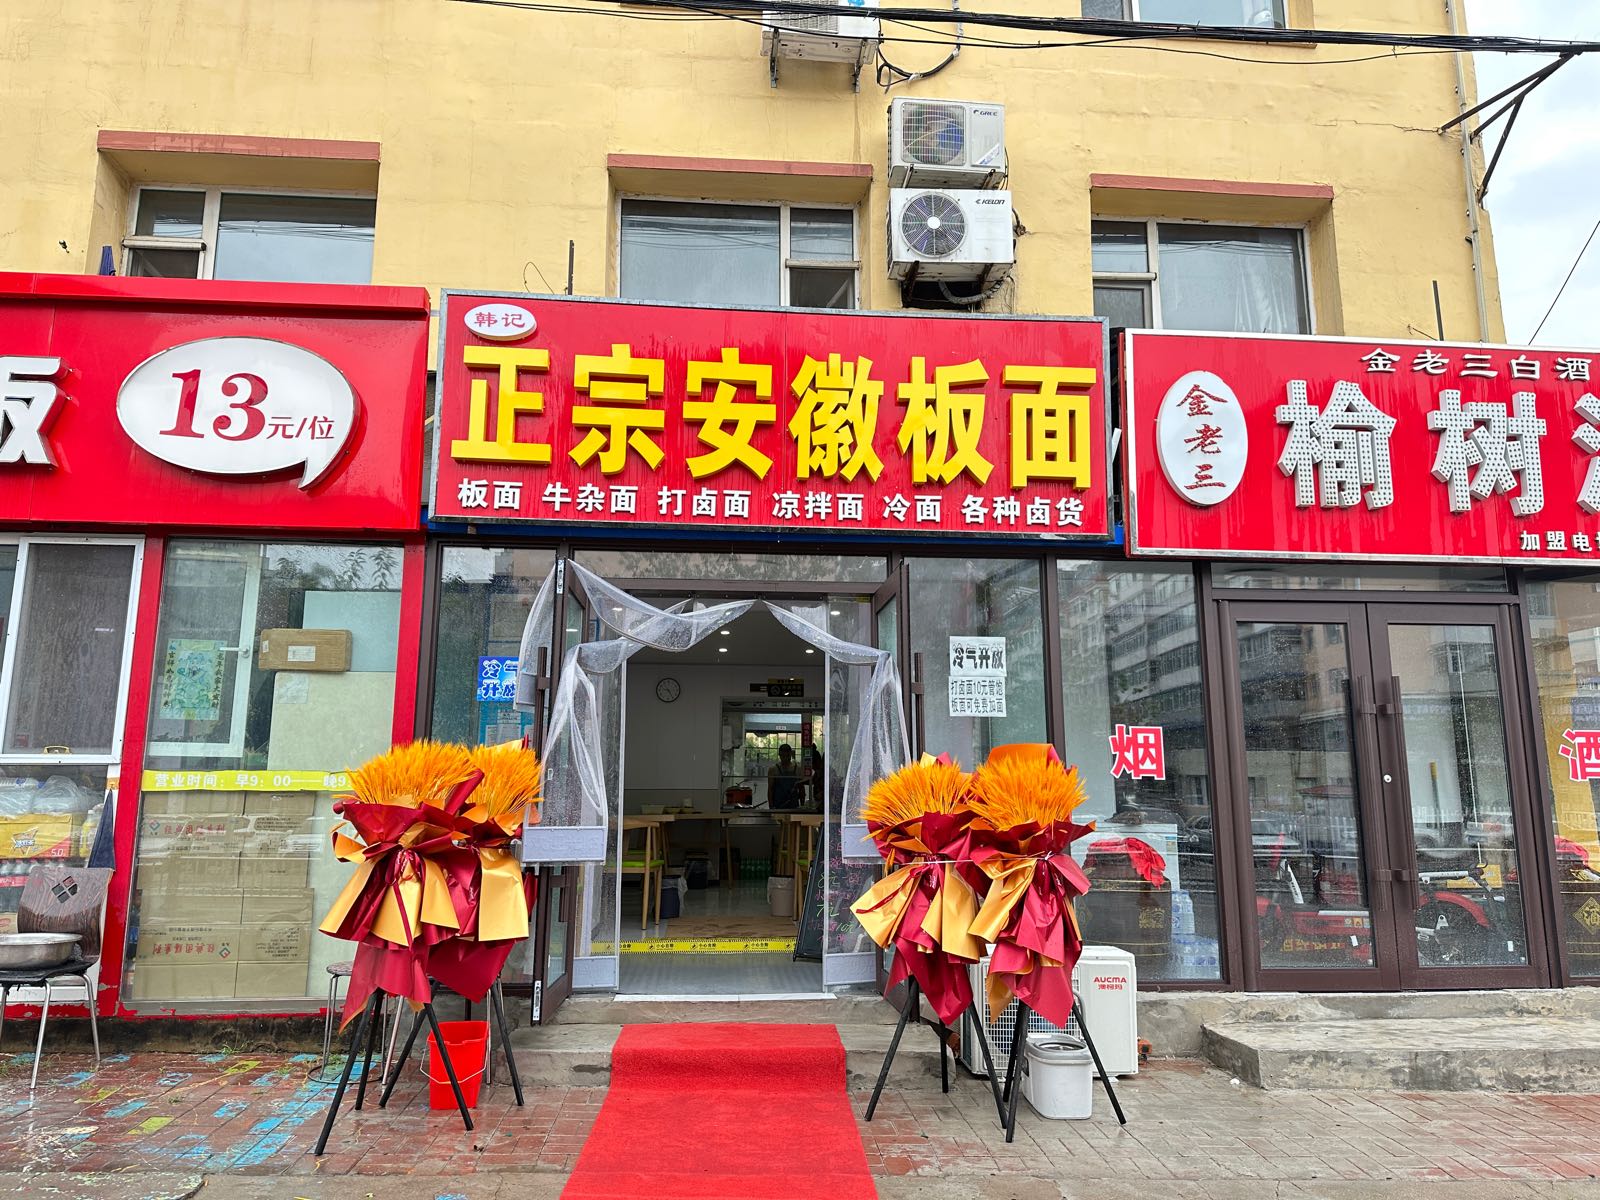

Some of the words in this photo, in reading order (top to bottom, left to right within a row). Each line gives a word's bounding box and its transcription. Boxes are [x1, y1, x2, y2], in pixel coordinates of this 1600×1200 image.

[474, 311, 525, 330] 韩记
[1361, 347, 1592, 381] 金老三白酒
[451, 343, 1097, 490] 正宗安徽板面
[1176, 384, 1228, 489] 金老三
[457, 478, 523, 511] 板面
[541, 481, 639, 515] 牛杂面
[657, 485, 752, 518] 打卤面
[771, 490, 865, 522] 凉拌面
[882, 493, 943, 523] 冷面
[960, 494, 1085, 528] 各种卤货
[1520, 530, 1600, 552] 加盟电
[952, 642, 1004, 670] 冷气开放
[1109, 724, 1167, 780] 烟
[1559, 728, 1600, 781] 酒
